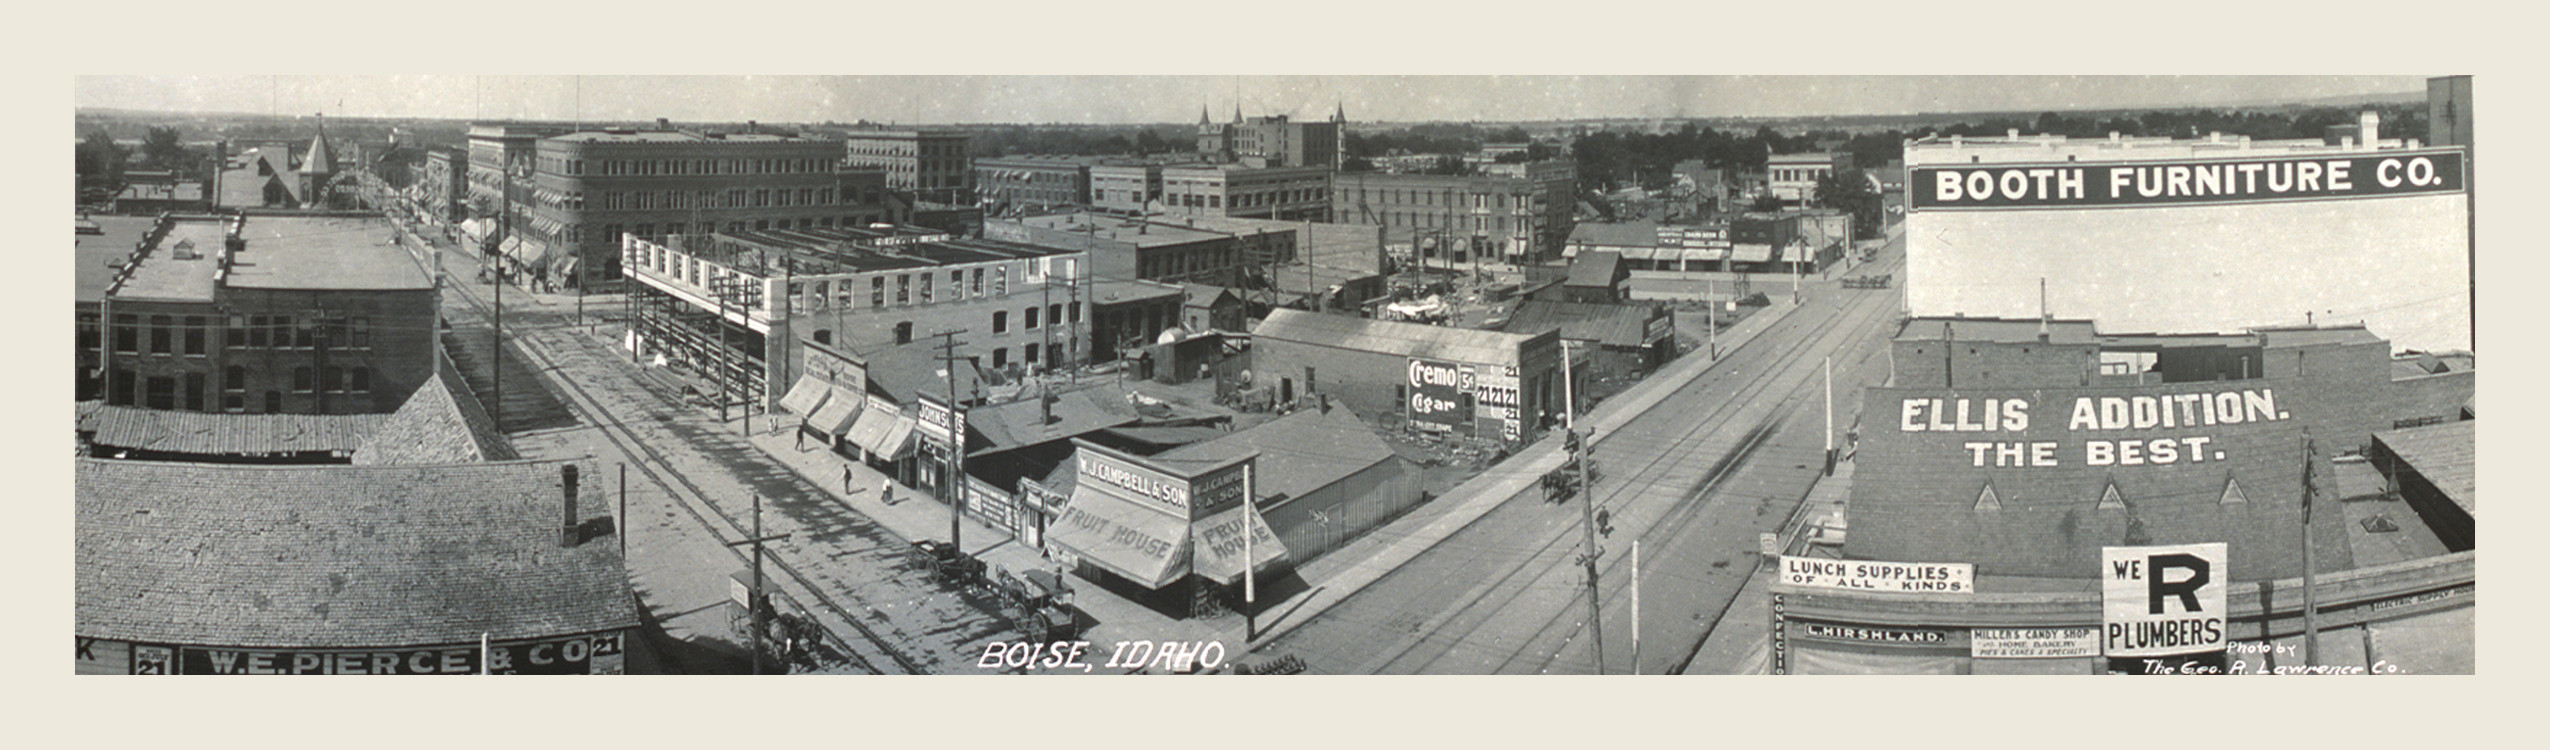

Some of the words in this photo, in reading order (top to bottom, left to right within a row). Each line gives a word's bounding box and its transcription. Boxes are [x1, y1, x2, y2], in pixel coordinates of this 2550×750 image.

[1936, 168, 2084, 201] BOOTH
[2110, 160, 2352, 198] FURNITURE
[2376, 156, 2442, 188] CO.
[1409, 360, 1457, 388] Cremo
[1505, 366, 1519, 378] 21
[1411, 393, 1456, 414] Cigar
[1478, 385, 1491, 407] 21
[1491, 386, 1505, 408] 21
[1505, 387, 1519, 409] 21
[1504, 409, 1519, 420] 21
[1900, 398, 2029, 432] ELLIS
[2068, 388, 2291, 431] ADDITION.
[1505, 425, 1518, 436] 21
[1964, 441, 2058, 468] THE
[2086, 436, 2226, 467] BEST.
[1063, 506, 1110, 534] FRUIT
[1111, 525, 1173, 560] HOUSE
[1789, 560, 1846, 577] LUNCH
[1857, 565, 1950, 580] SUPPLIES
[1793, 575, 1817, 584] OF
[1836, 578, 1875, 588] ALL
[1902, 581, 1961, 591] KINDS
[2113, 560, 2141, 580] WE
[2148, 553, 2210, 615] R
[2025, 630, 2057, 640] CANDY
[2063, 629, 2090, 639] SHOP
[2109, 618, 2222, 650] PLUMBERS
[490, 647, 513, 670] &
[529, 639, 589, 665] CO
[593, 637, 622, 657] 21
